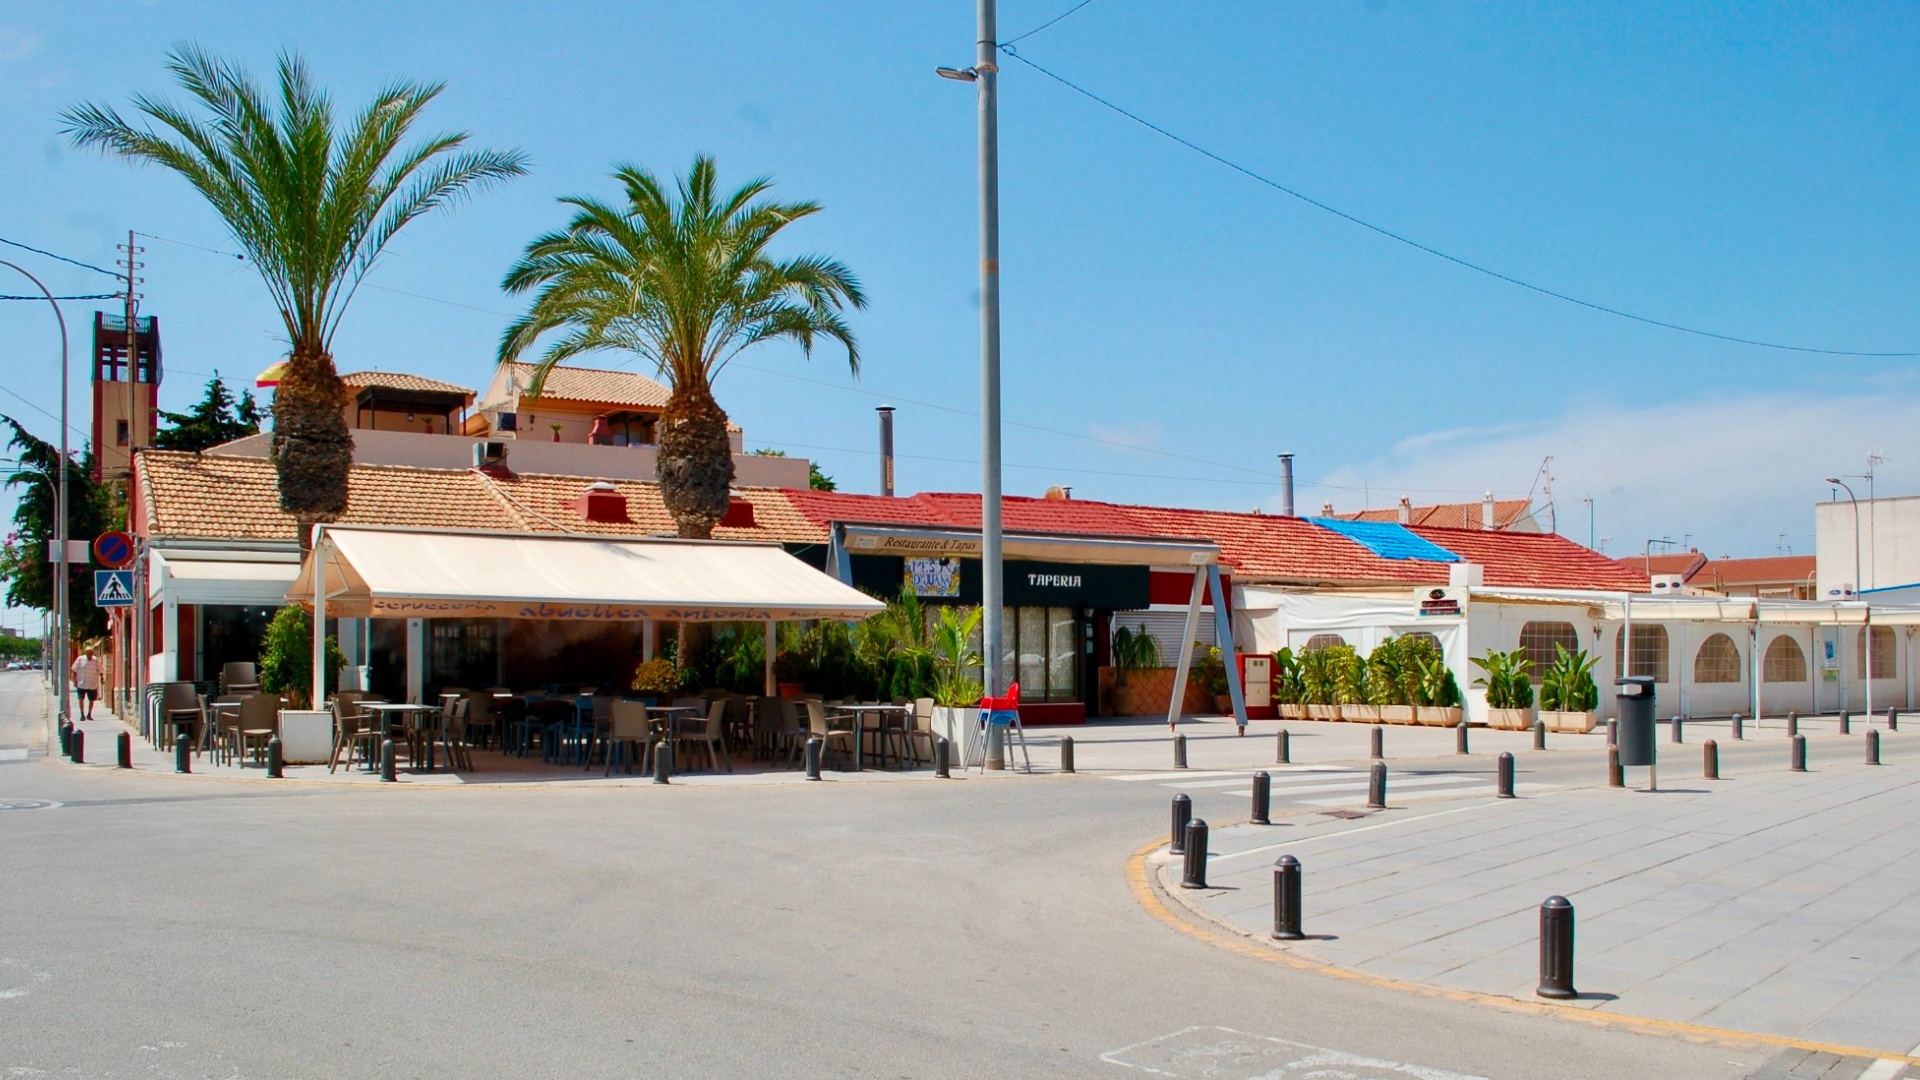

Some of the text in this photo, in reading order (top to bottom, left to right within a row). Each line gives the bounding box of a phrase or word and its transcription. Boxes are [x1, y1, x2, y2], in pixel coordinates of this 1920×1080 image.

[884, 537, 940, 549] Restaurante
[940, 540, 949, 550] &
[950, 540, 977, 552] Tapas
[1028, 574, 1082, 587] TAPERIA
[665, 607, 771, 619] antonia
